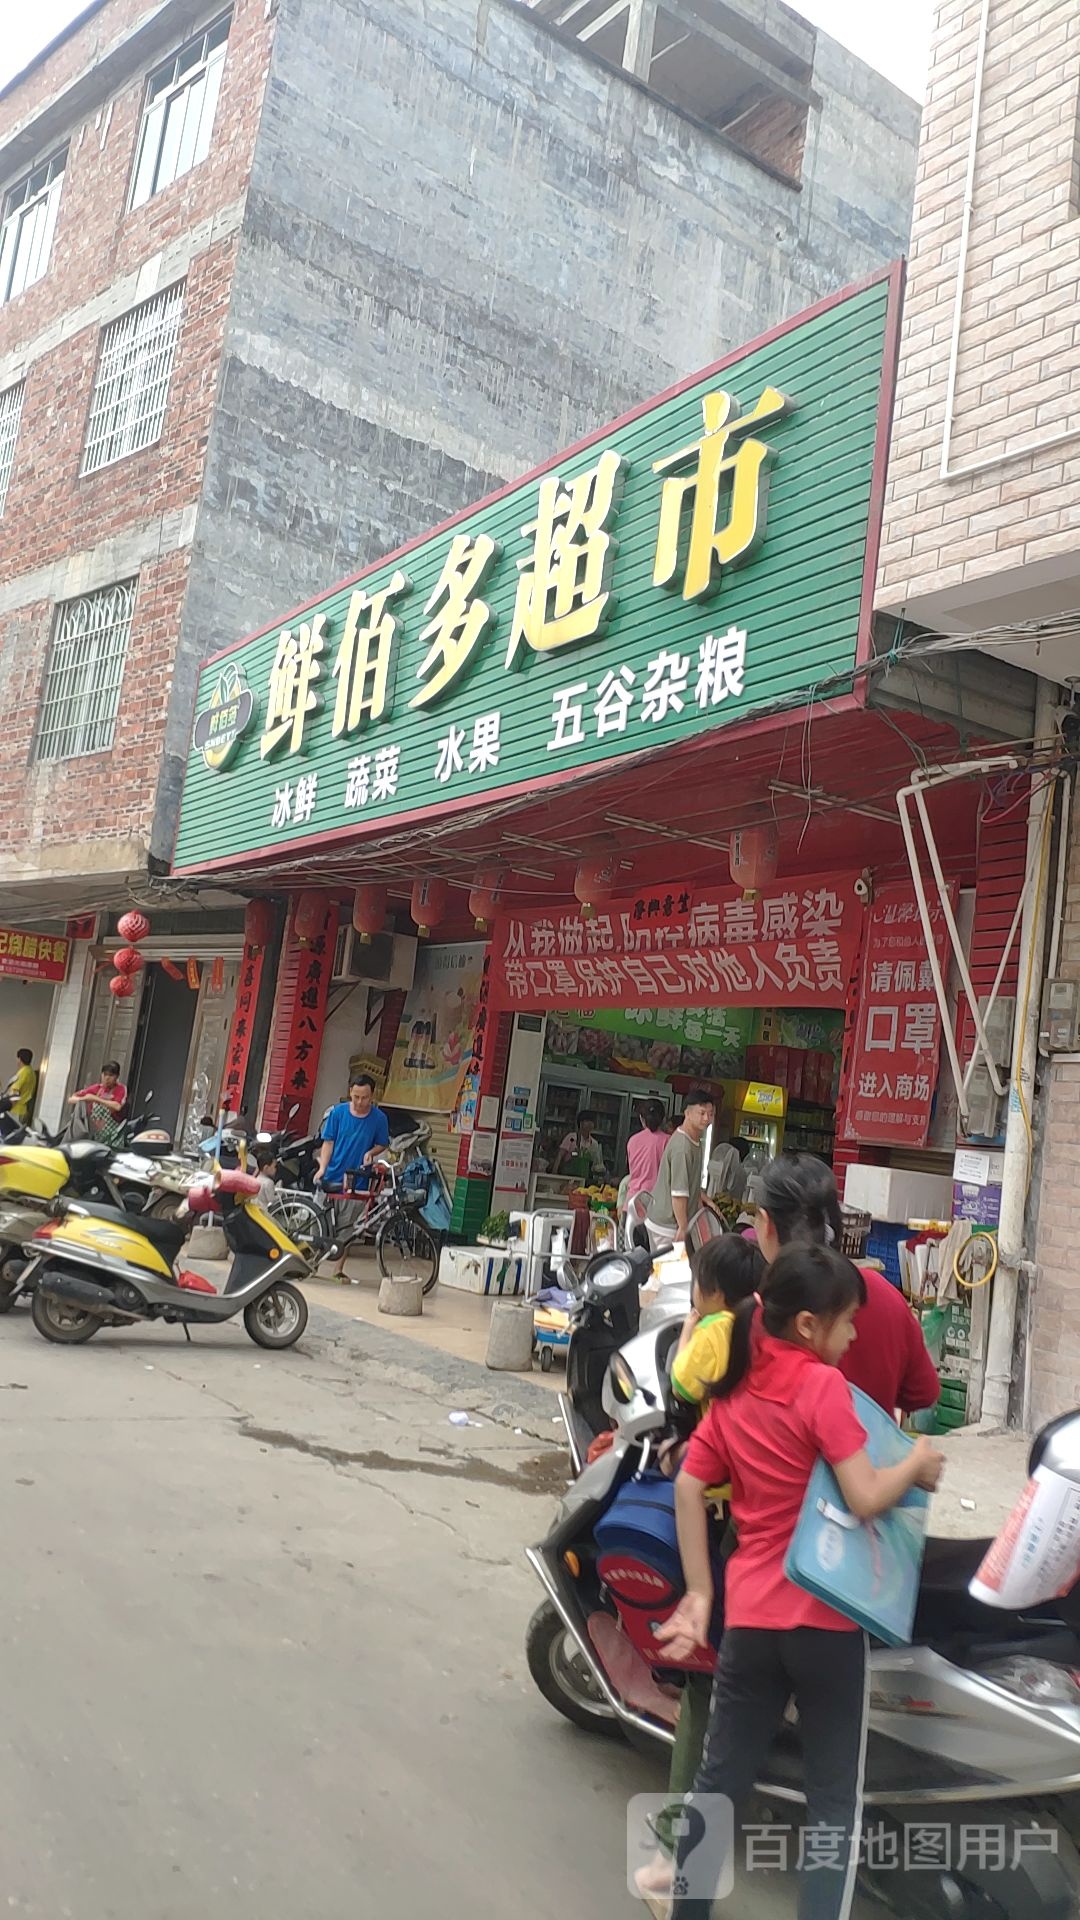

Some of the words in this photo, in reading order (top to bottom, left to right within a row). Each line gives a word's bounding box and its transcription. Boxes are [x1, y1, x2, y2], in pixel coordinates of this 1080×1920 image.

[260, 385, 794, 762] 鲜佰多超市
[546, 626, 748, 751] 五谷杂粮
[434, 712, 500, 782] 水果
[271, 772, 318, 828] 冰鲜
[344, 746, 401, 808] 蔬菜
[684, 1019, 741, 1048] 每一天
[864, 1002, 937, 1055] 口罩
[858, 1071, 930, 1101] 进入商场
